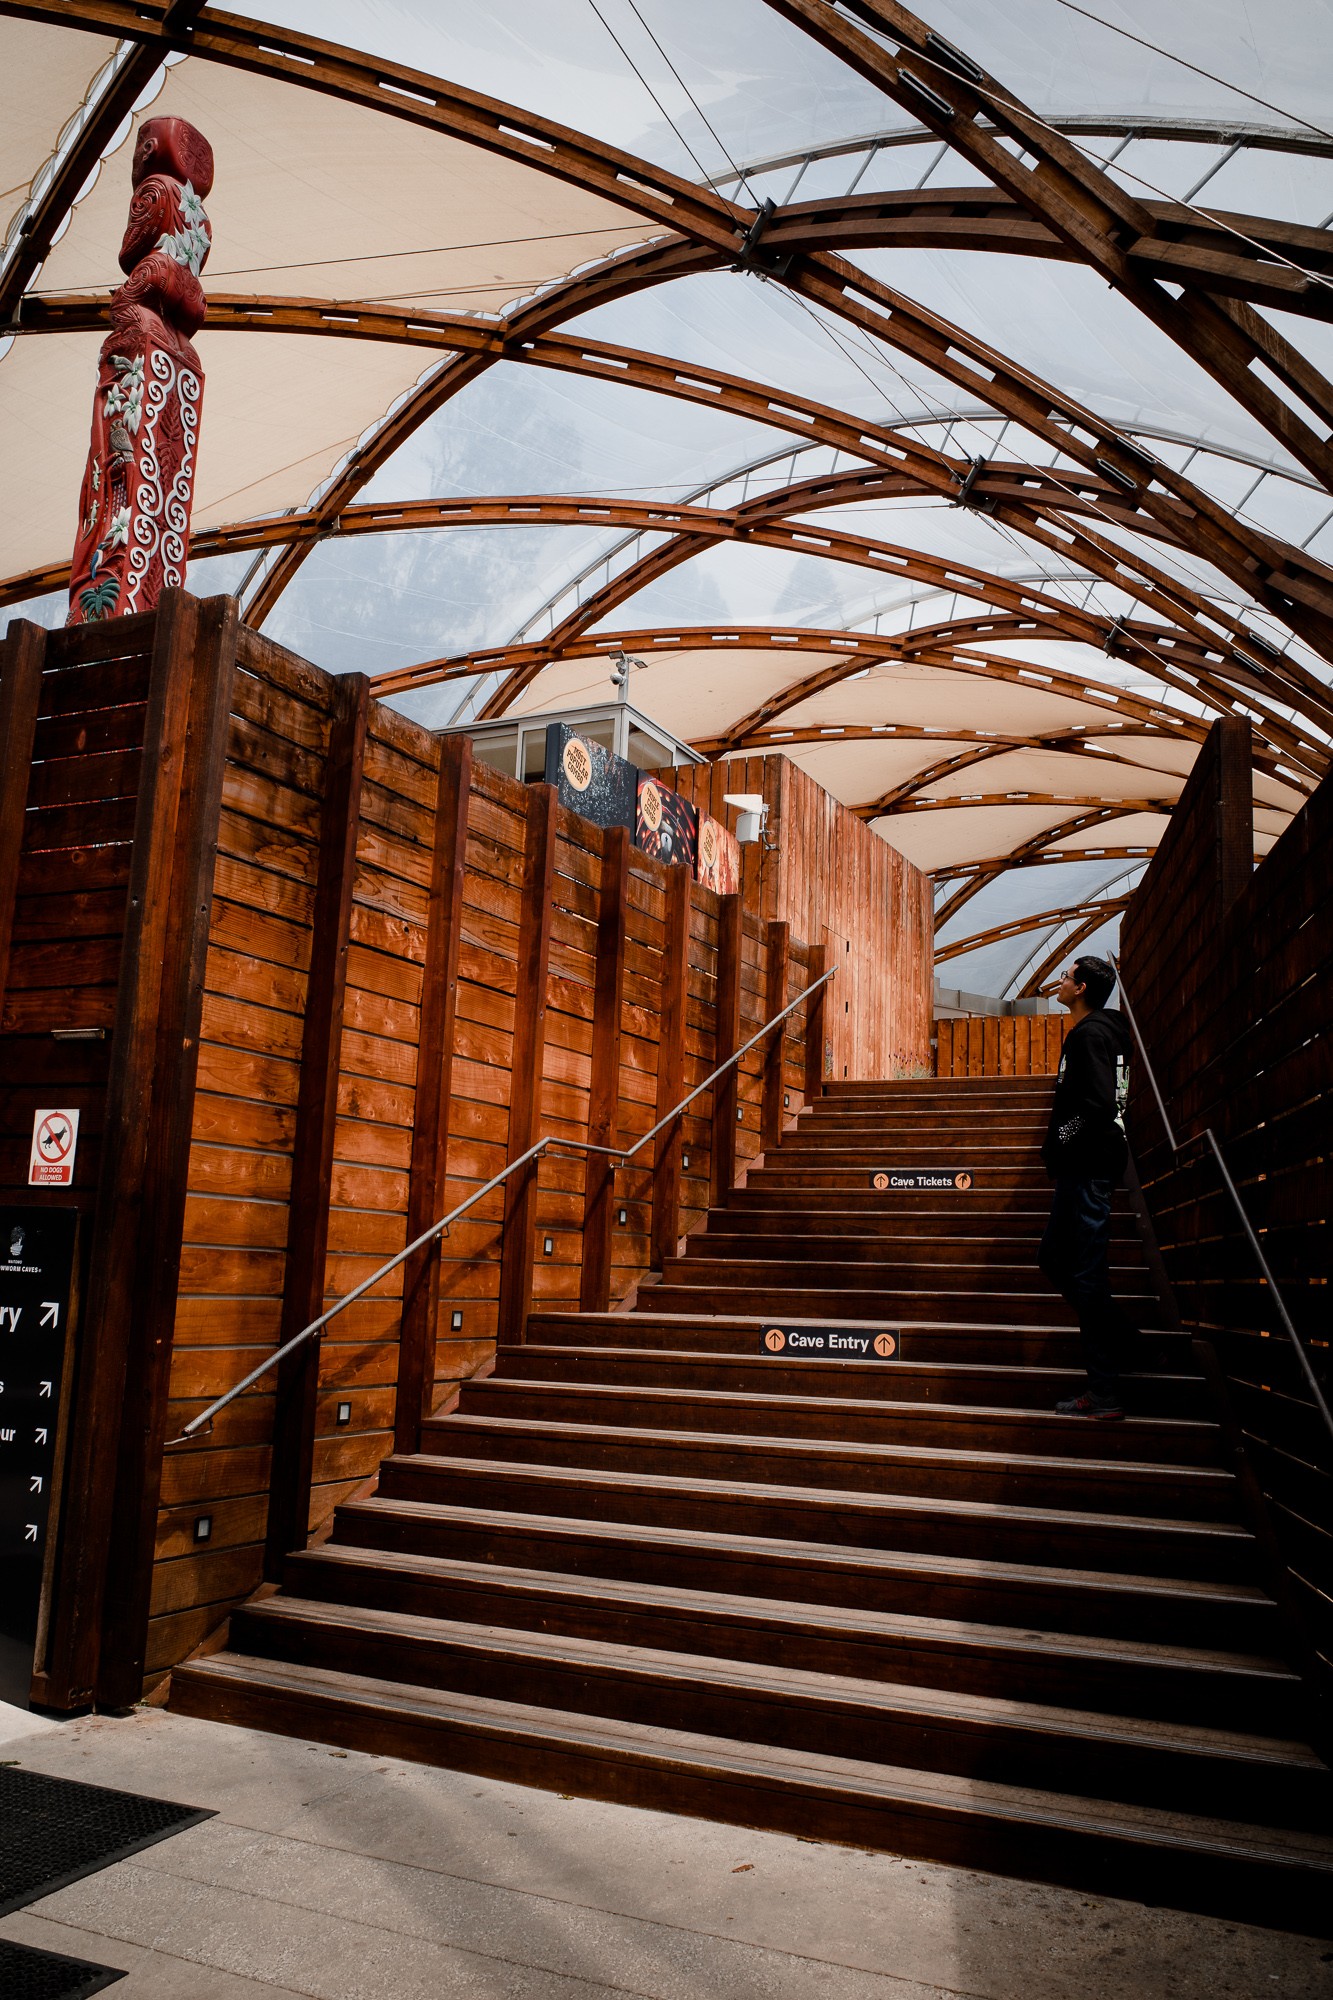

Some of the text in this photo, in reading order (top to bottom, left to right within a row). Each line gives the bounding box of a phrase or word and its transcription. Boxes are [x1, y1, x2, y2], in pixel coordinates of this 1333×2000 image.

[566, 749, 589, 780] POPULAR
[573, 746, 587, 765] MOST
[567, 761, 584, 784] COMBO
[890, 1176, 953, 1187] Cave Tickets
[788, 1332, 870, 1353] Cave Entry
[0, 1427, 17, 1442] ur
